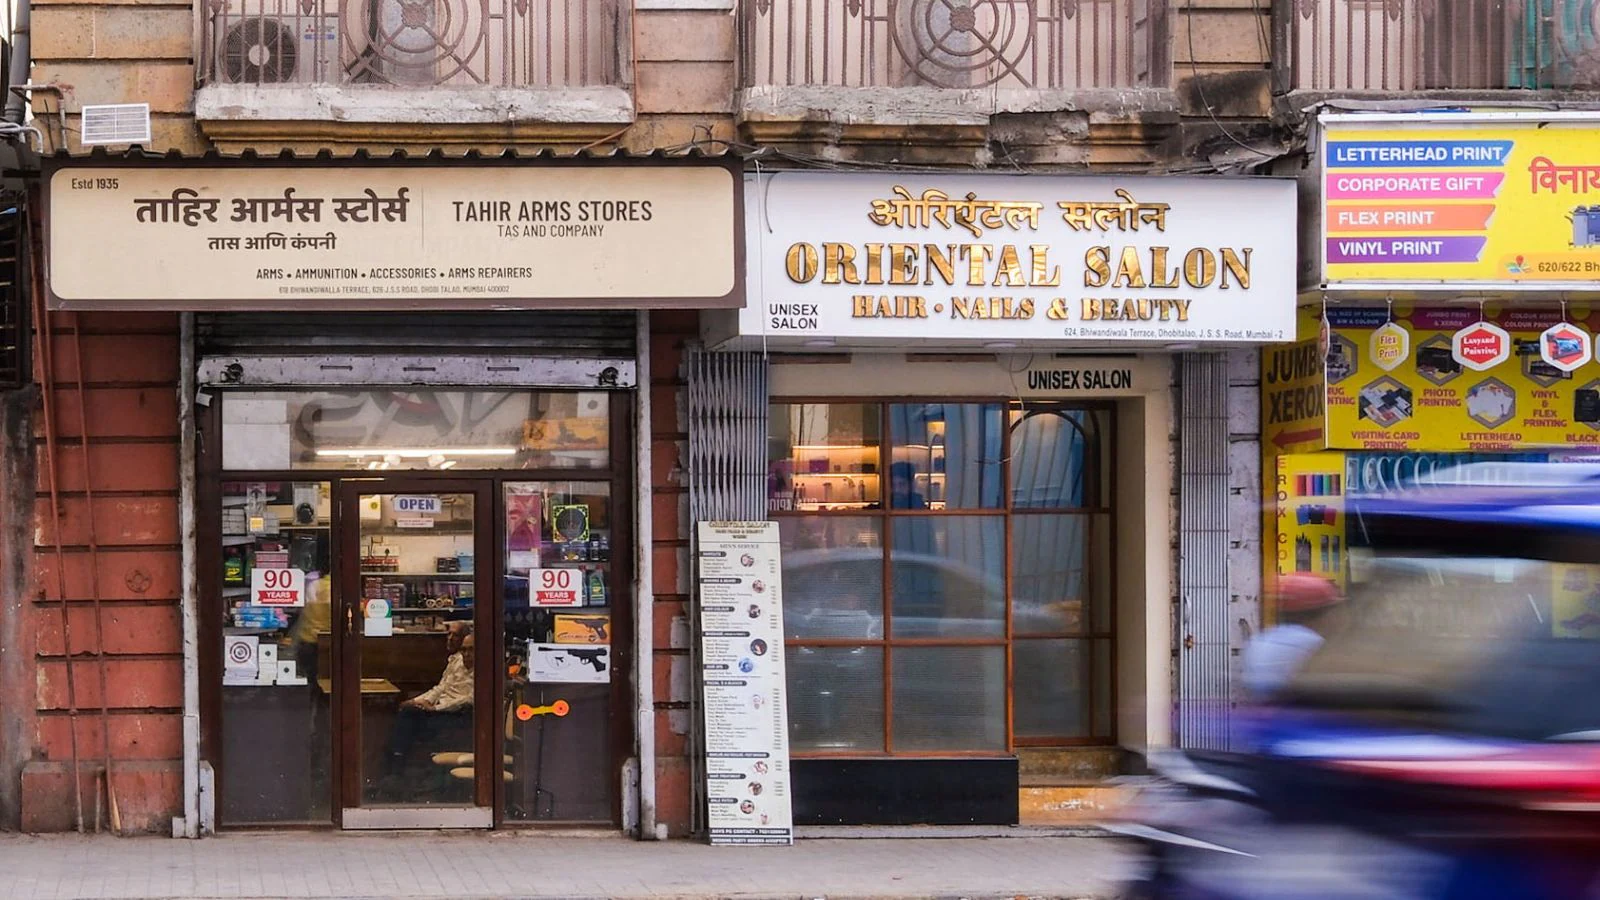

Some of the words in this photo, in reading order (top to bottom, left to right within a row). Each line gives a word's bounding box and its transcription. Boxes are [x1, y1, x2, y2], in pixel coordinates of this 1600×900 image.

[1337, 147, 1448, 162] LETTERHEAD
[1452, 146, 1503, 161] PRINT
[71, 178, 93, 190] Estd
[96, 178, 119, 190] 1935
[1337, 177, 1441, 192] CORPORATE
[1446, 177, 1484, 191] GIFT
[134, 187, 220, 227] ताहिर
[332, 187, 410, 223] स्टोर्स
[452, 200, 511, 222] TAHIR
[518, 200, 571, 221] ARMS
[578, 200, 653, 221] STORES
[868, 185, 1043, 238] ओरिएंटल
[1058, 188, 1171, 232] सलोन
[1338, 211, 1379, 225] FLEX
[1383, 211, 1435, 225] PRINT
[497, 224, 520, 238] TAS
[522, 224, 547, 237] AND
[550, 224, 605, 237] COMPANY
[208, 235, 241, 251] तास
[244, 232, 288, 251] आणि
[290, 231, 337, 251] कंपनी
[1338, 242, 1387, 256] VINYL
[1391, 241, 1443, 256] PRINT
[785, 241, 1061, 287] ORIENTAL
[1084, 245, 1253, 290] SALON
[1538, 262, 1582, 272] 620/622
[256, 268, 284, 280] ARMS
[295, 268, 358, 280] AMMUNITION
[369, 268, 437, 279] ACCESSORIES
[448, 267, 476, 279] ARMS
[478, 267, 533, 279] REPAIRERS
[769, 303, 819, 316] UNISEX
[852, 295, 928, 318] HAIR
[951, 296, 1035, 319] NAILS
[1047, 297, 1069, 320] &
[1081, 298, 1192, 321] BEAUTY
[771, 317, 818, 330] SALON
[1129, 328, 1157, 338] Terrace,
[1246, 329, 1273, 339] Mumbai
[1380, 335, 1397, 345] Flex
[1463, 336, 1496, 346] Lanyard
[1379, 349, 1398, 359] Print
[1463, 347, 1498, 356] Printing
[1028, 370, 1079, 389] UNISEX
[1082, 369, 1132, 388] SALON
[1423, 389, 1456, 397] PHOTO
[1531, 390, 1560, 399] VINYL
[1269, 385, 1325, 424] XEROX
[1327, 396, 1355, 405] NTING
[1418, 399, 1461, 407] PRINTING
[1533, 409, 1557, 417] FLEX
[1523, 419, 1568, 427] PRINTING
[1351, 431, 1391, 440] VISITING
[1393, 431, 1420, 440] CARD
[1460, 432, 1522, 441] LETTERHEAD
[1566, 433, 1599, 442] BLACK
[1363, 441, 1407, 449] PRINTING
[1277, 458, 1287, 518] EROX
[399, 498, 435, 510] OPEN
[1277, 532, 1288, 577] COL
[264, 569, 292, 589] 90
[542, 569, 570, 589] 90
[266, 591, 291, 599] YEARS
[545, 591, 569, 599] YEARS
